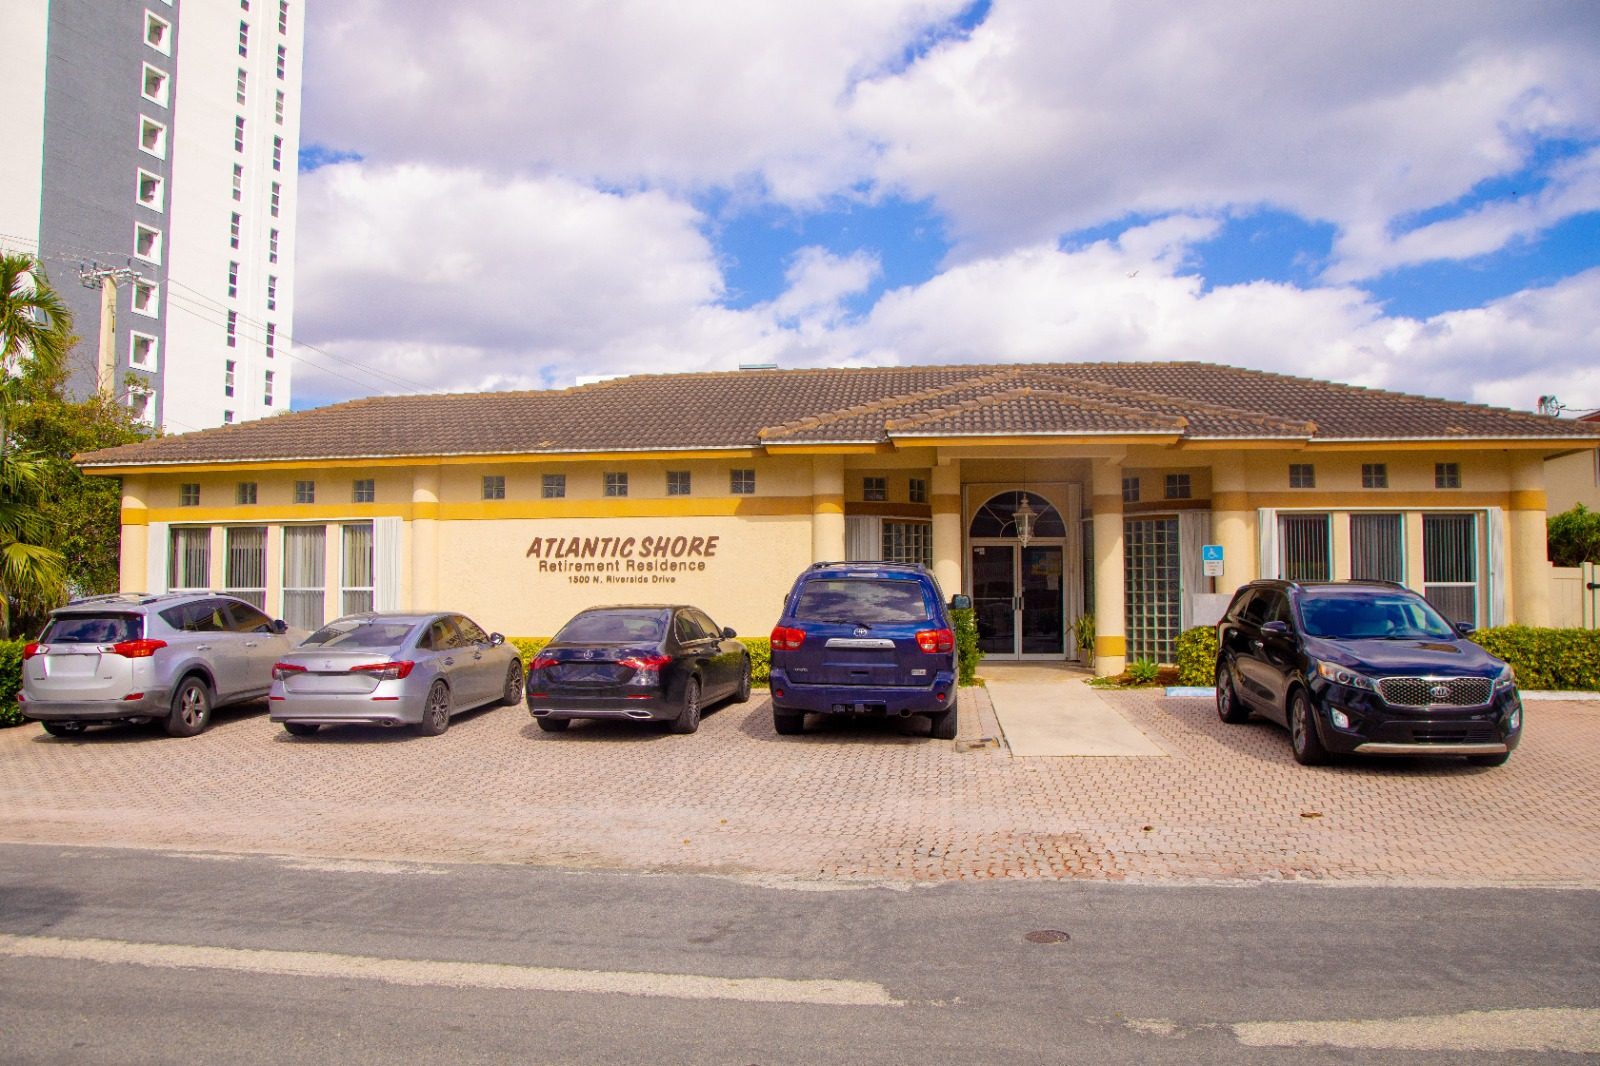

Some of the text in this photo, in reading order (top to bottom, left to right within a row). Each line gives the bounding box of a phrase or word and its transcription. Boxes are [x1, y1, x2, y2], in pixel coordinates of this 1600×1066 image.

[526, 535, 720, 558] ATLANTIC SHORE
[539, 559, 706, 573] Retirement Residence
[568, 575, 590, 584] 1500
[606, 575, 649, 584] Riverside
[652, 574, 676, 584] Drive
